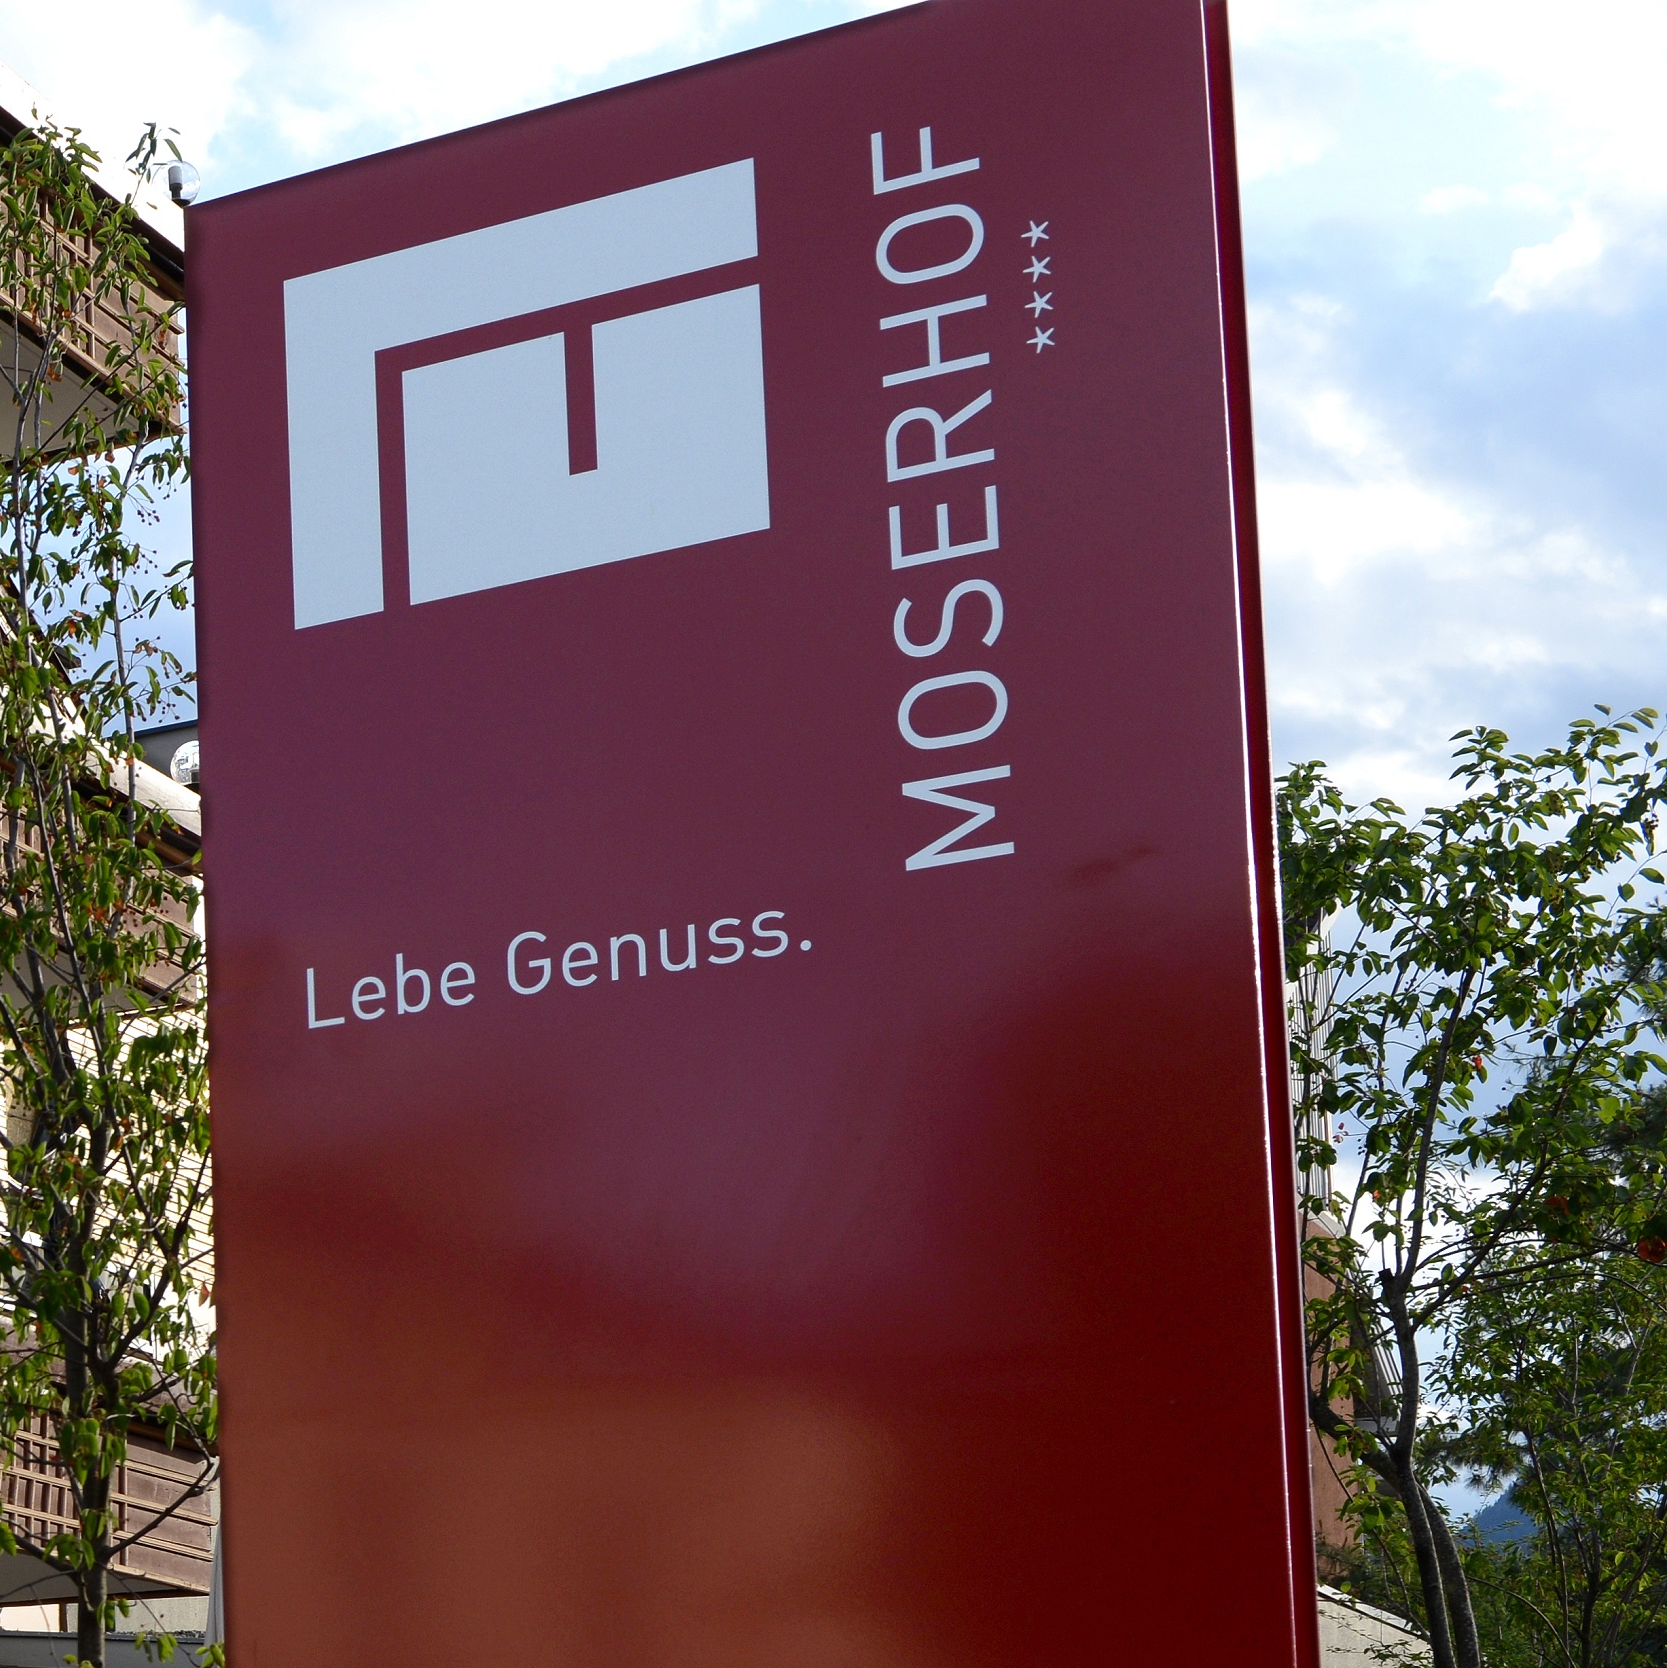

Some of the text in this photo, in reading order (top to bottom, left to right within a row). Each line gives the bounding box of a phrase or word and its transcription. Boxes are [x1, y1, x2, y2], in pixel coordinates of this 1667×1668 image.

[870, 126, 1015, 872] MOSERHOF
[306, 909, 813, 1029] Lebe Genuss.
